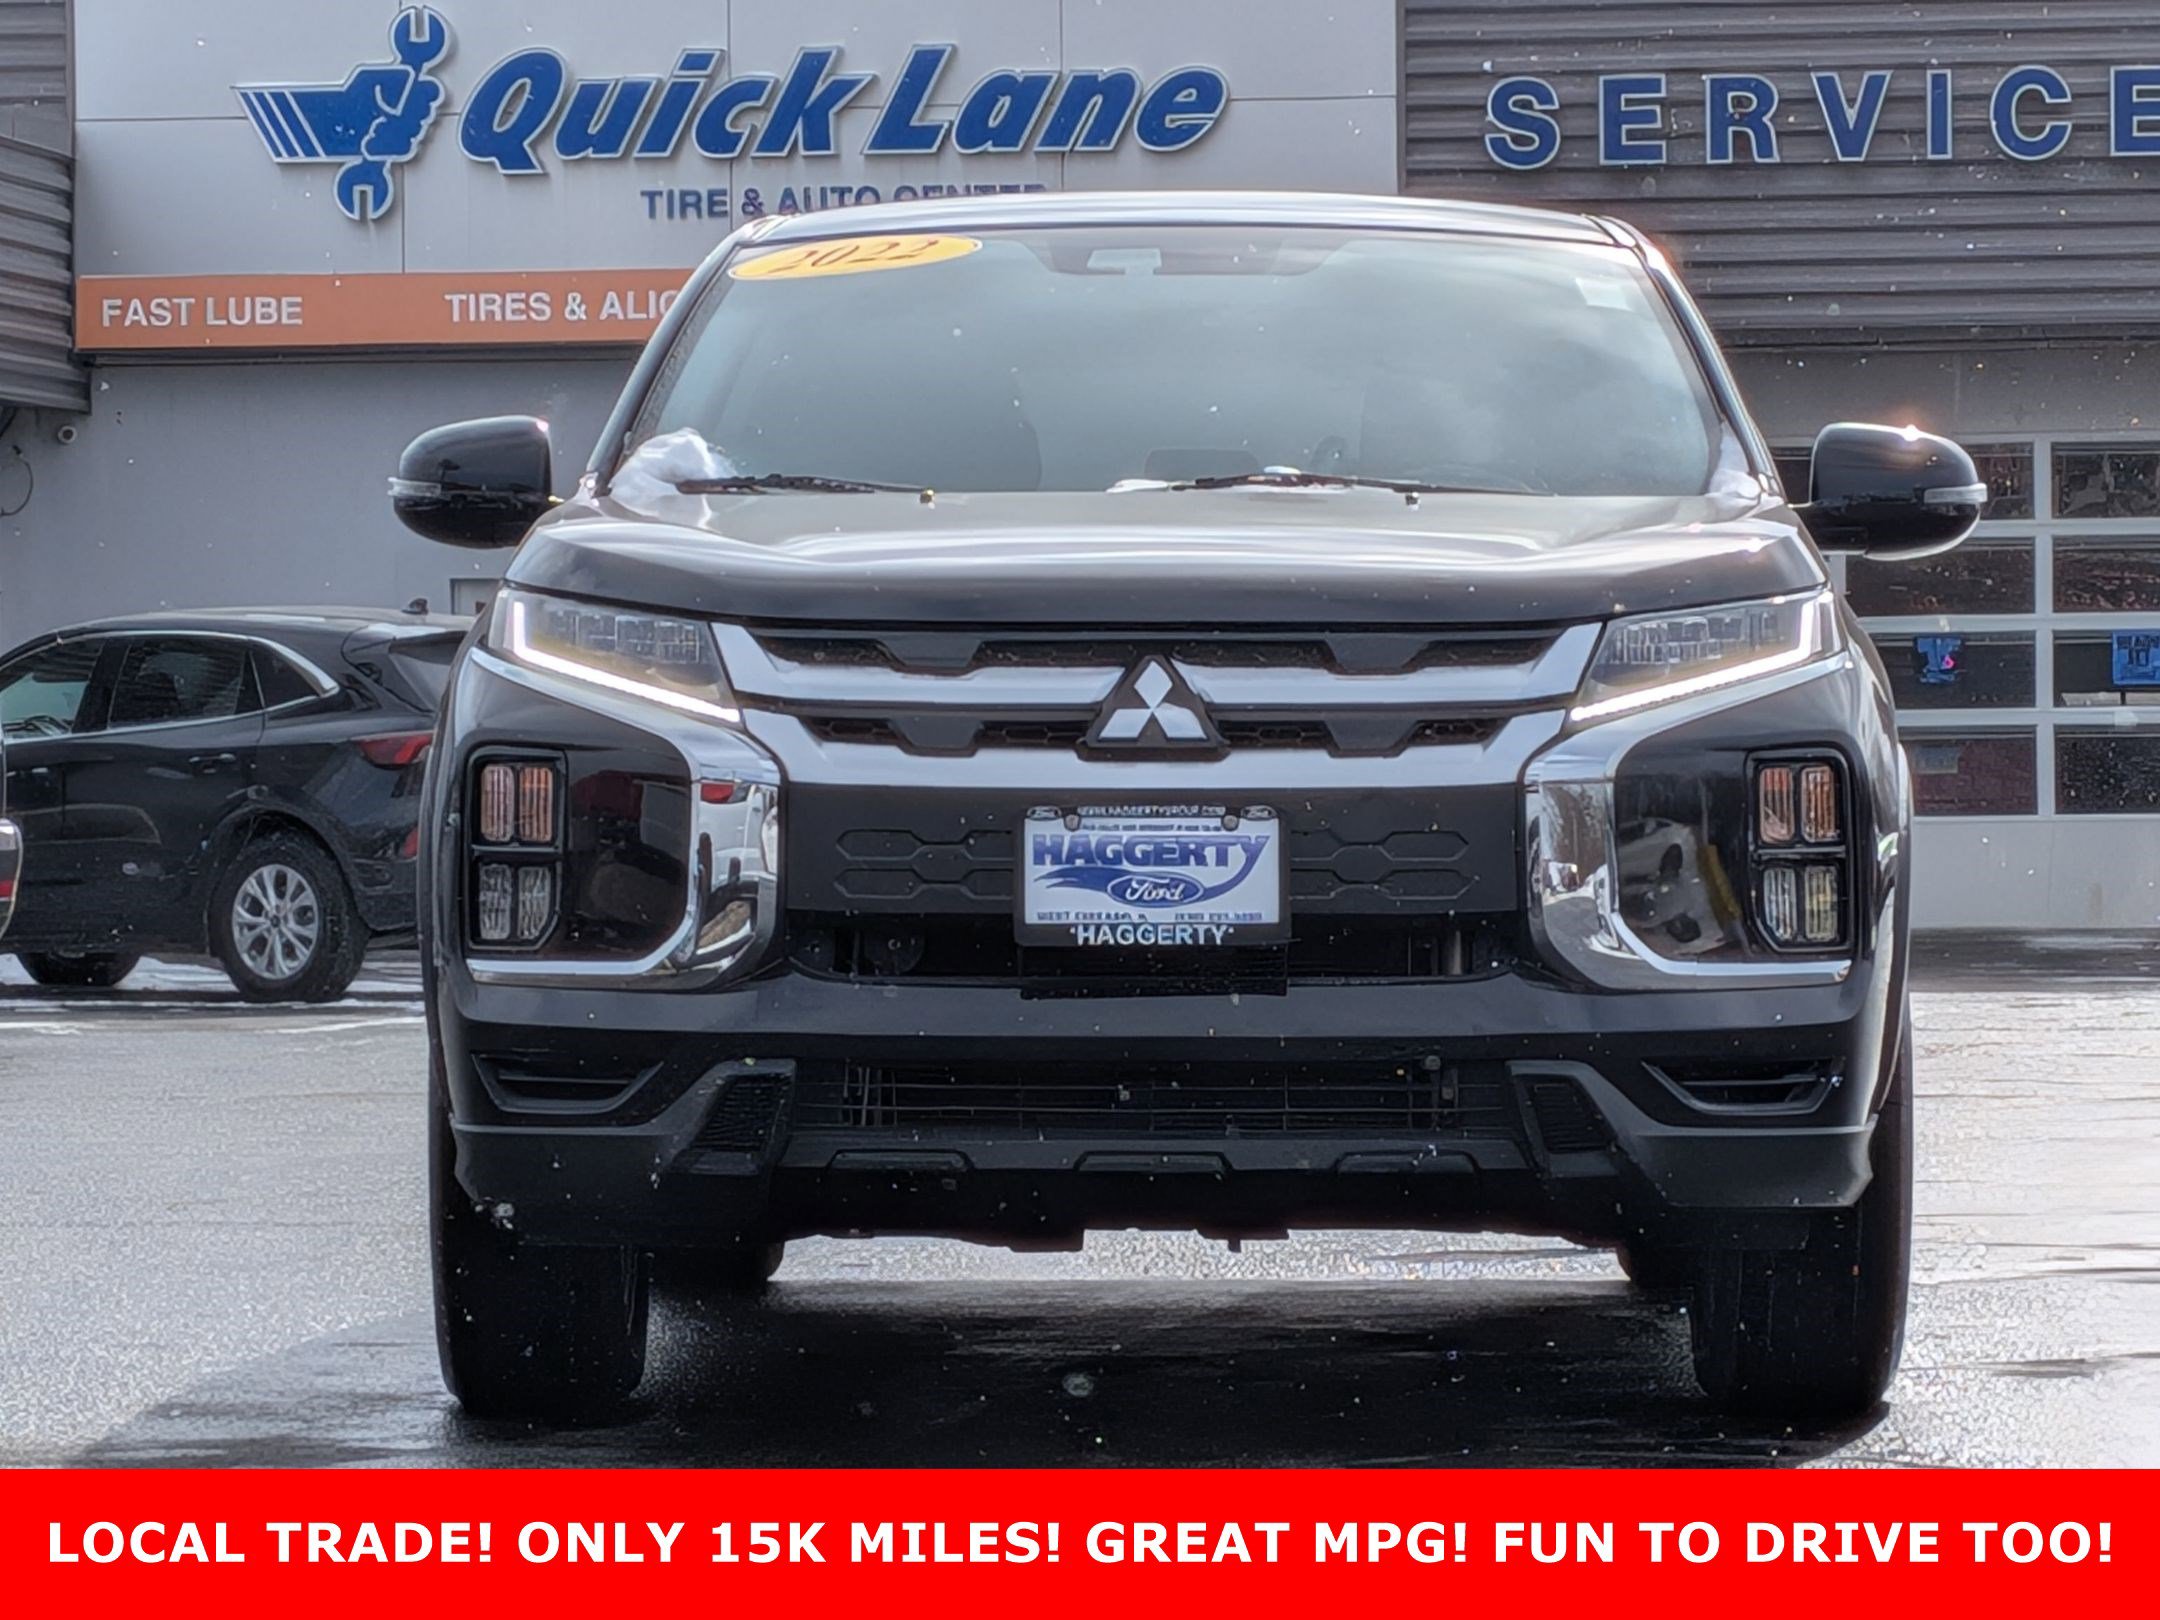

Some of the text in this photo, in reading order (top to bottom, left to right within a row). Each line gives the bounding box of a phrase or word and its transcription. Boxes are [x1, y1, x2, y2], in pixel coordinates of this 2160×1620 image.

[457, 43, 1228, 175] Quick Lane
[1484, 65, 2160, 170] SERVICE
[640, 189, 729, 220] TIRE
[741, 188, 765, 217] &
[778, 186, 882, 215] AUTO
[767, 240, 940, 276] 2022
[101, 295, 304, 328] FAST LUBE
[444, 291, 552, 323] TIRES
[565, 291, 588, 321] &
[1032, 834, 1270, 868] HAGGERTY
[1125, 878, 1184, 901] Ford
[1076, 924, 1227, 946] HAGGERTY
